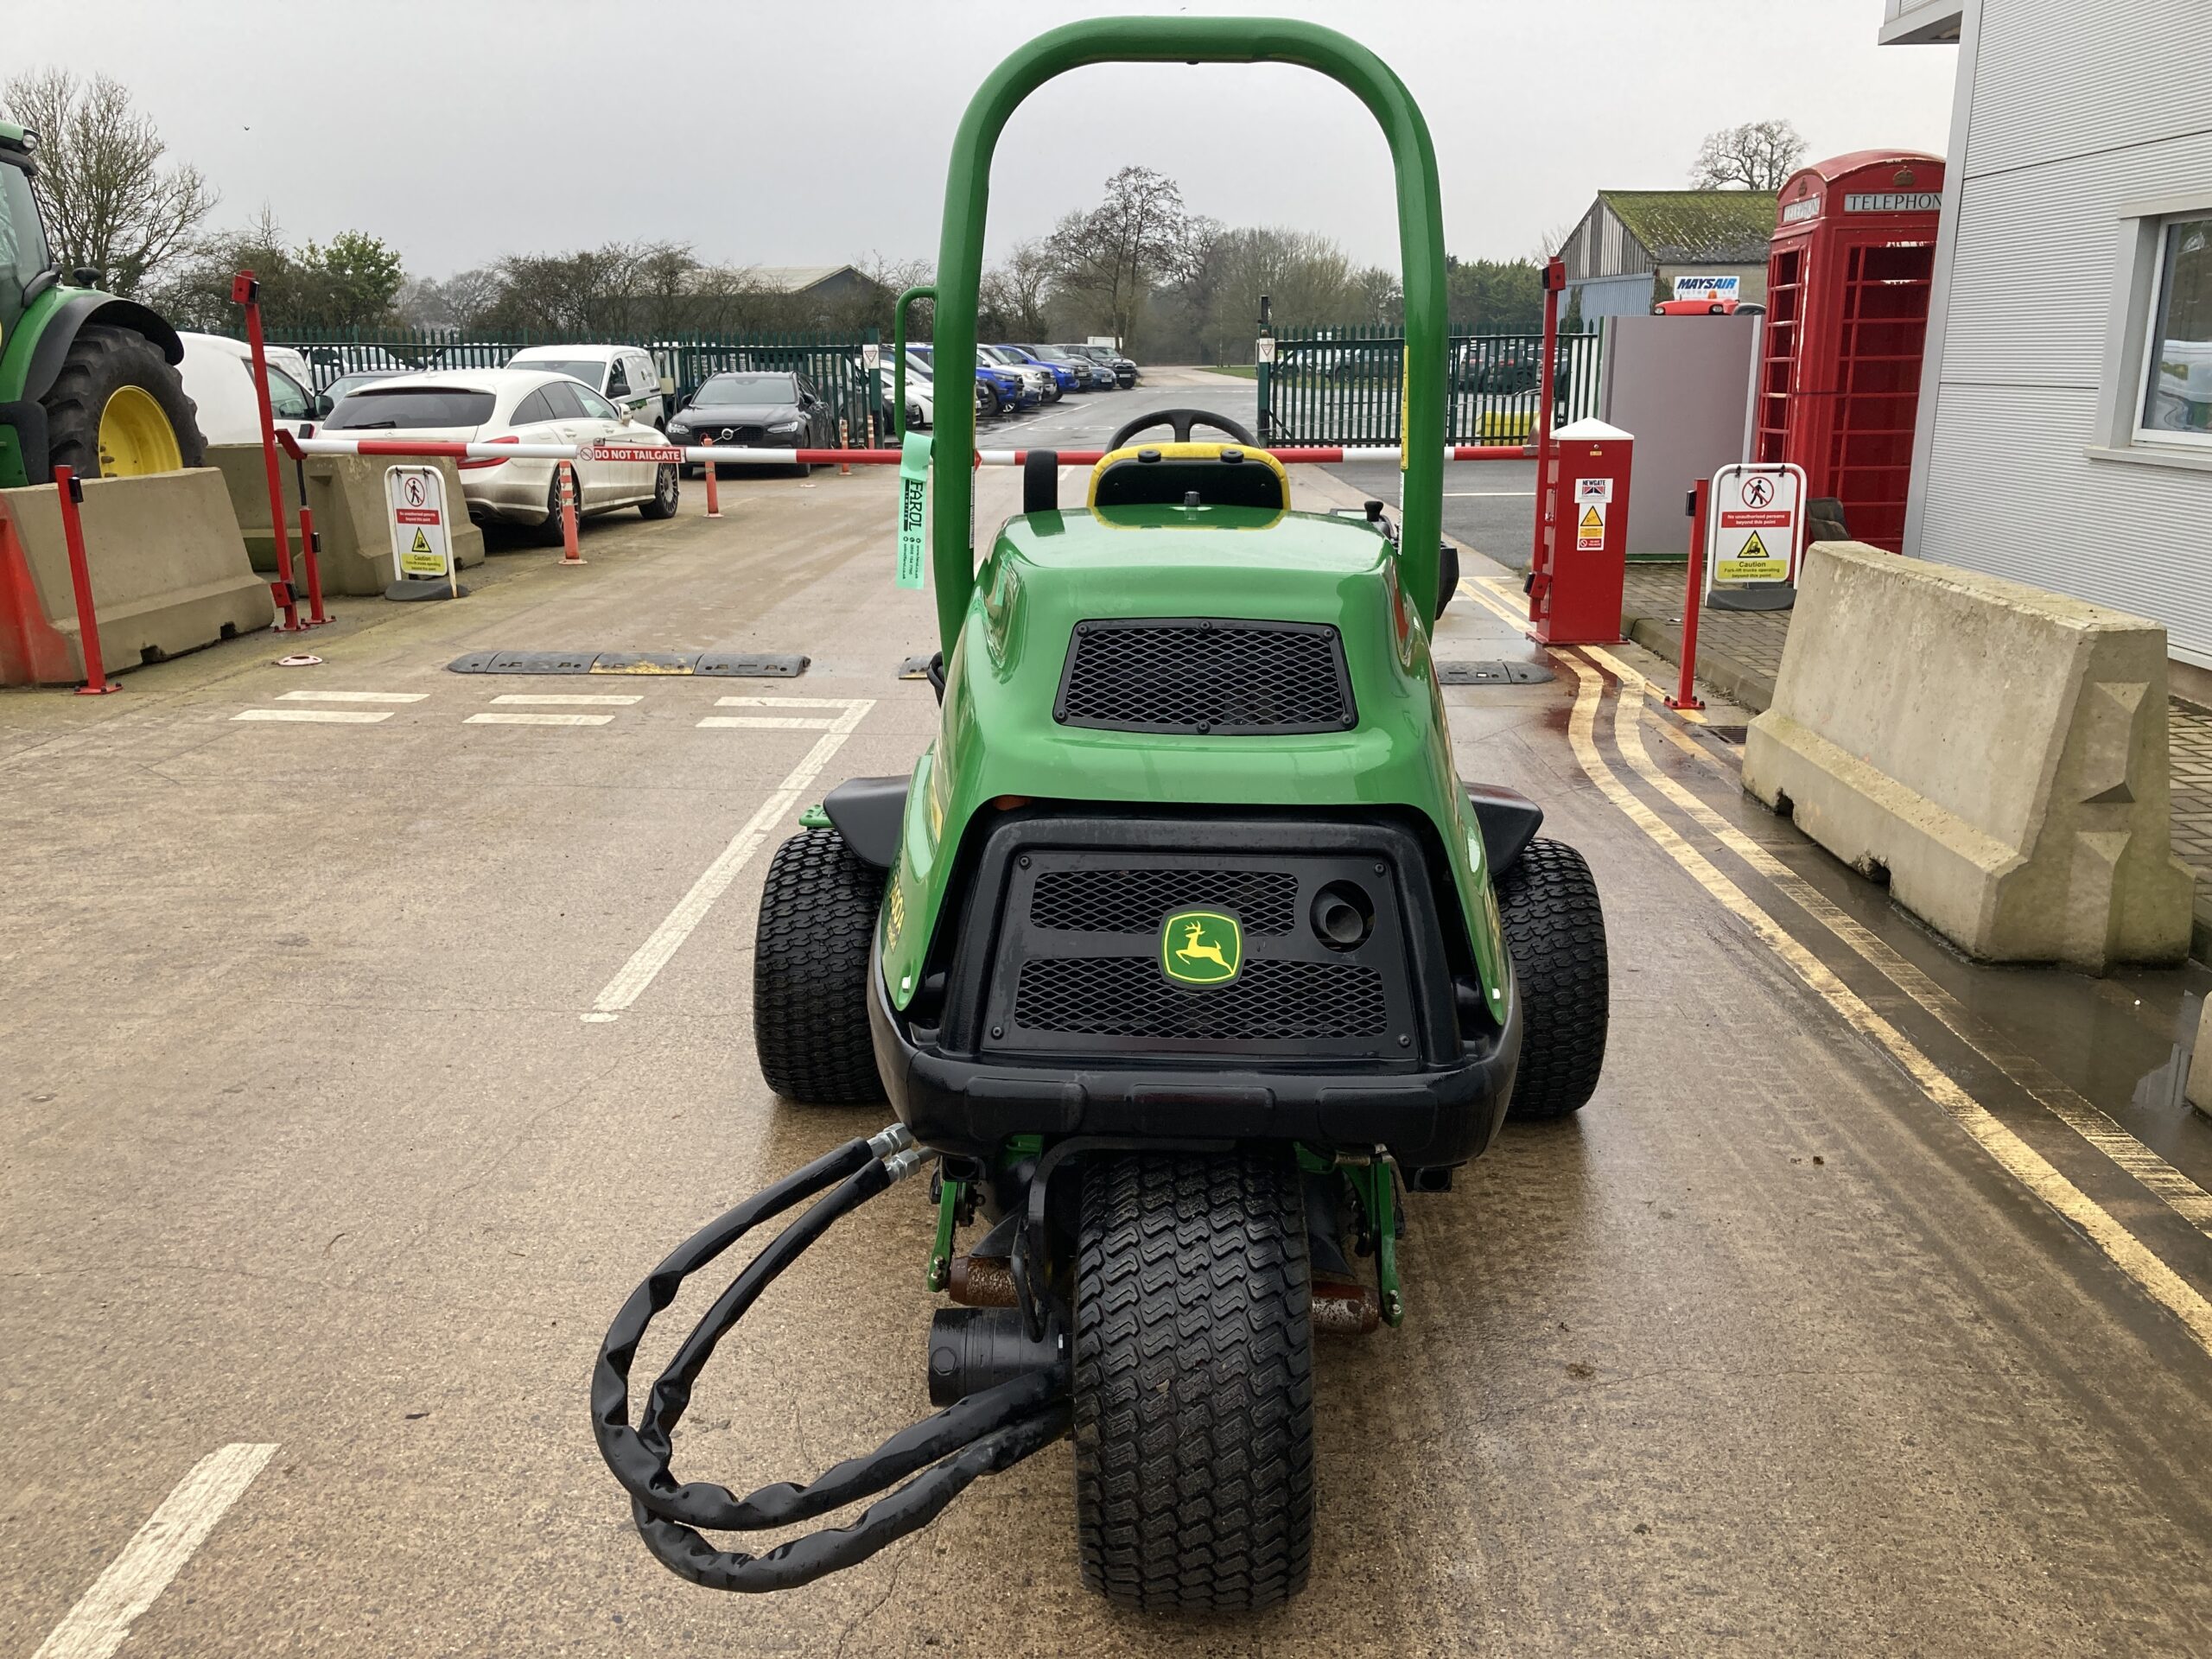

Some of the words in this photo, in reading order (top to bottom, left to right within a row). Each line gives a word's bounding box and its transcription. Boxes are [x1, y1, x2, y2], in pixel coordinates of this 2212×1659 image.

[1849, 194, 1942, 211] TELEPHON
[1677, 278, 1737, 289] MAYSAIR
[595, 450, 608, 459] DO
[612, 450, 632, 460] NOT
[632, 450, 680, 461] TAILGATE
[909, 481, 923, 531] FAROL
